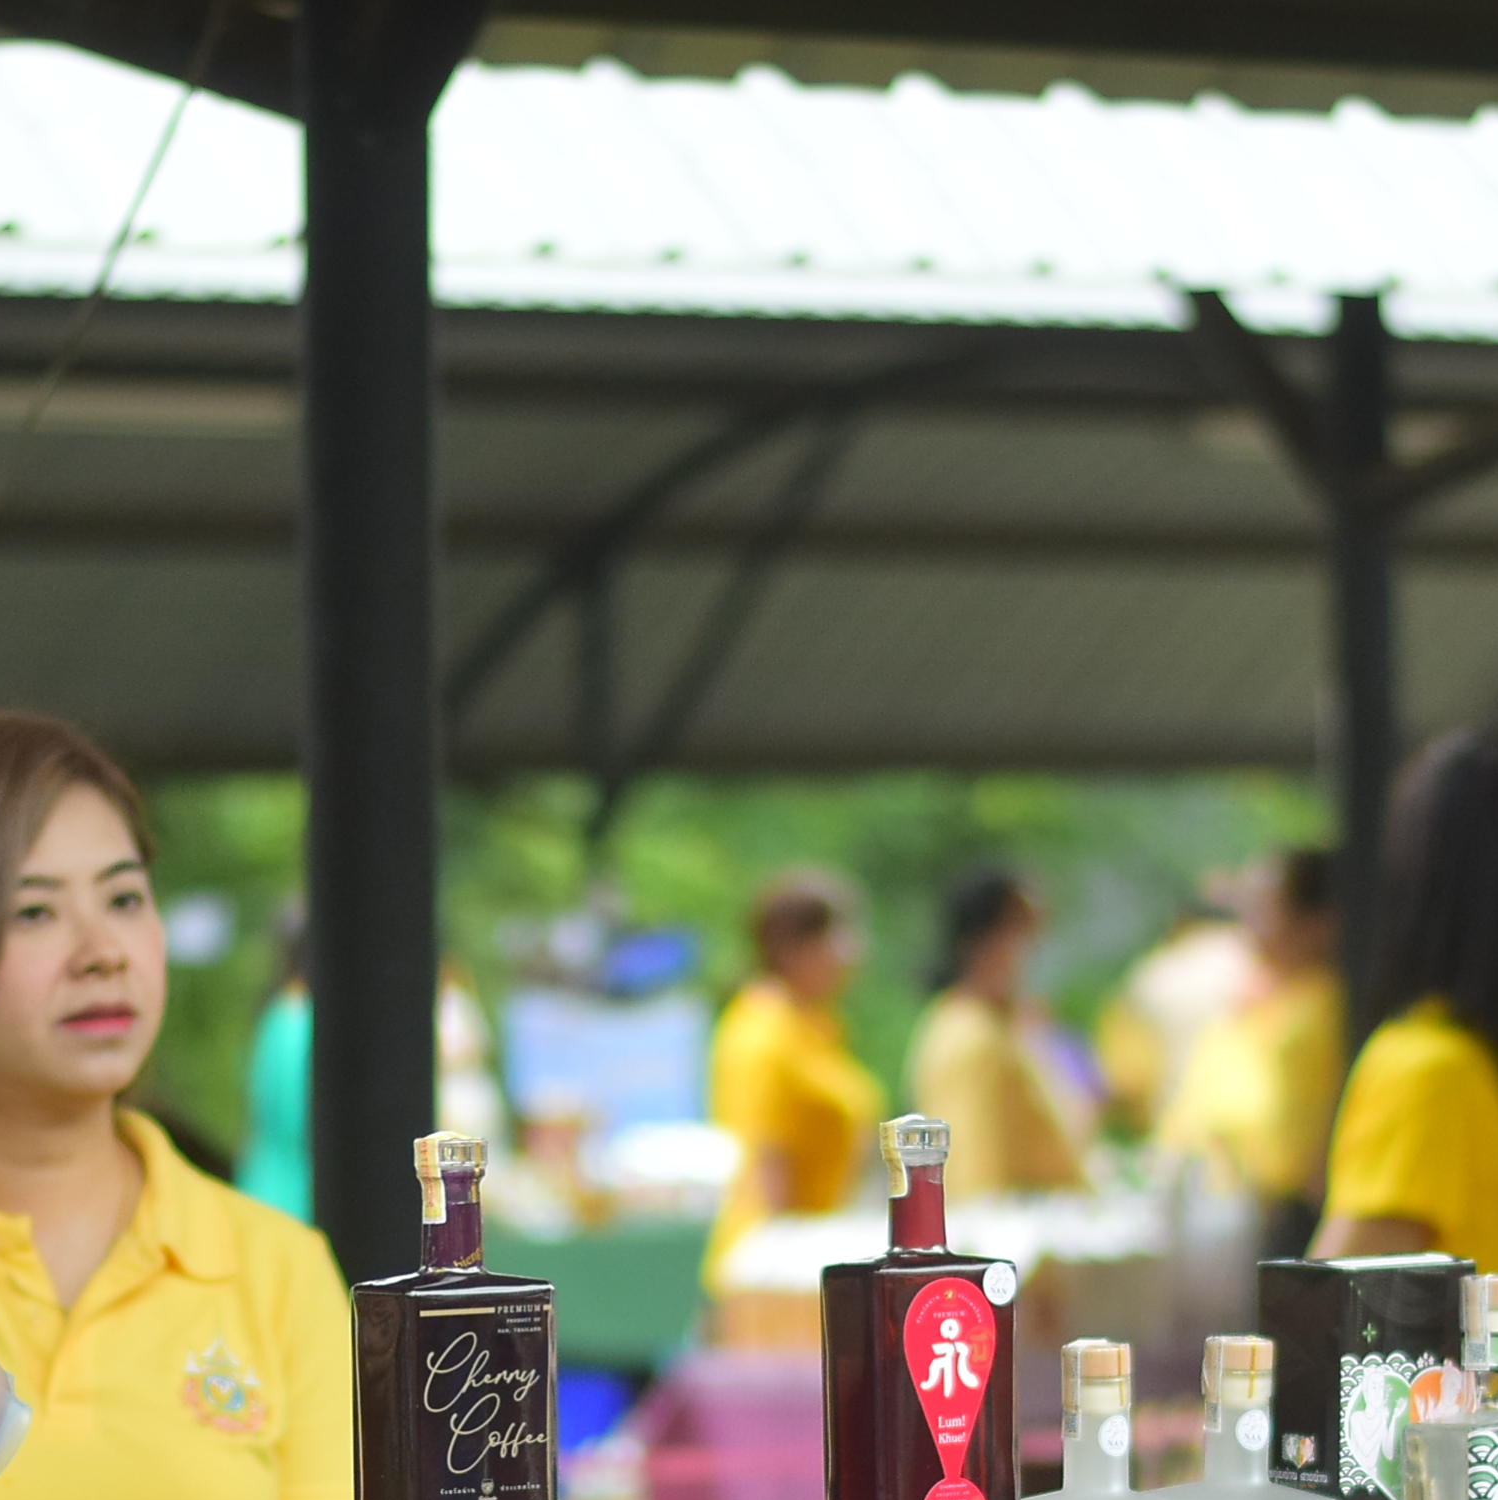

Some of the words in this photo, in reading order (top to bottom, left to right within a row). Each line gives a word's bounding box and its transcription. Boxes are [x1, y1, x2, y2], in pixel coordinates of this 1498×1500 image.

[497, 1304, 541, 1314] PREMIUM
[424, 1332, 540, 1412] Cherry
[937, 1415, 965, 1428] Lum!
[447, 1393, 549, 1474] Coffee
[938, 1432, 966, 1444] Khue!
